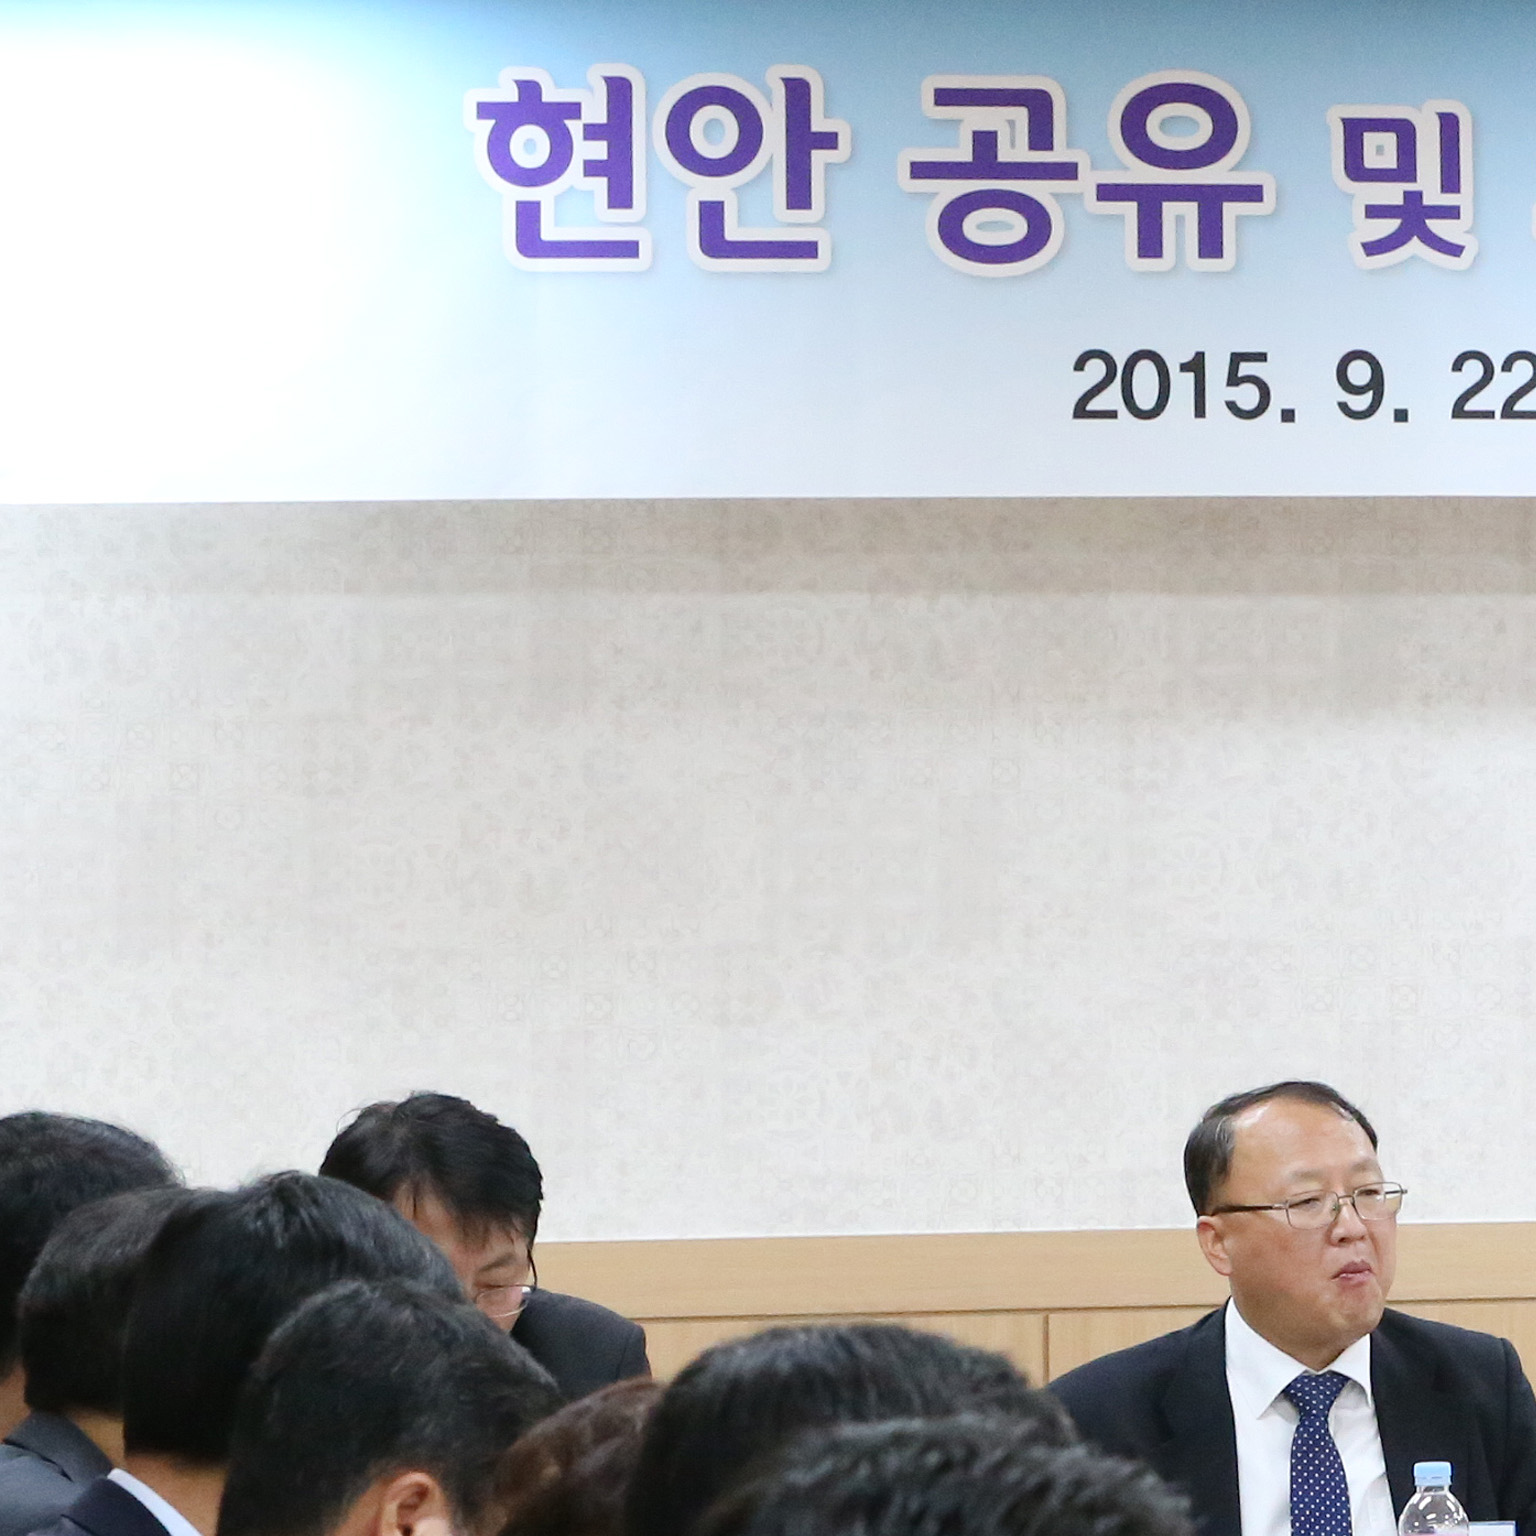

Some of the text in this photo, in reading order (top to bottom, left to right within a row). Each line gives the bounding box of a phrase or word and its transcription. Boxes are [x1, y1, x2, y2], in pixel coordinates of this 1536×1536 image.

[474, 74, 840, 261] 현안
[907, 81, 1265, 266] 공유
[1338, 110, 1468, 260] 및
[1071, 347, 1297, 424] 2015.
[1334, 348, 1410, 424] 9.
